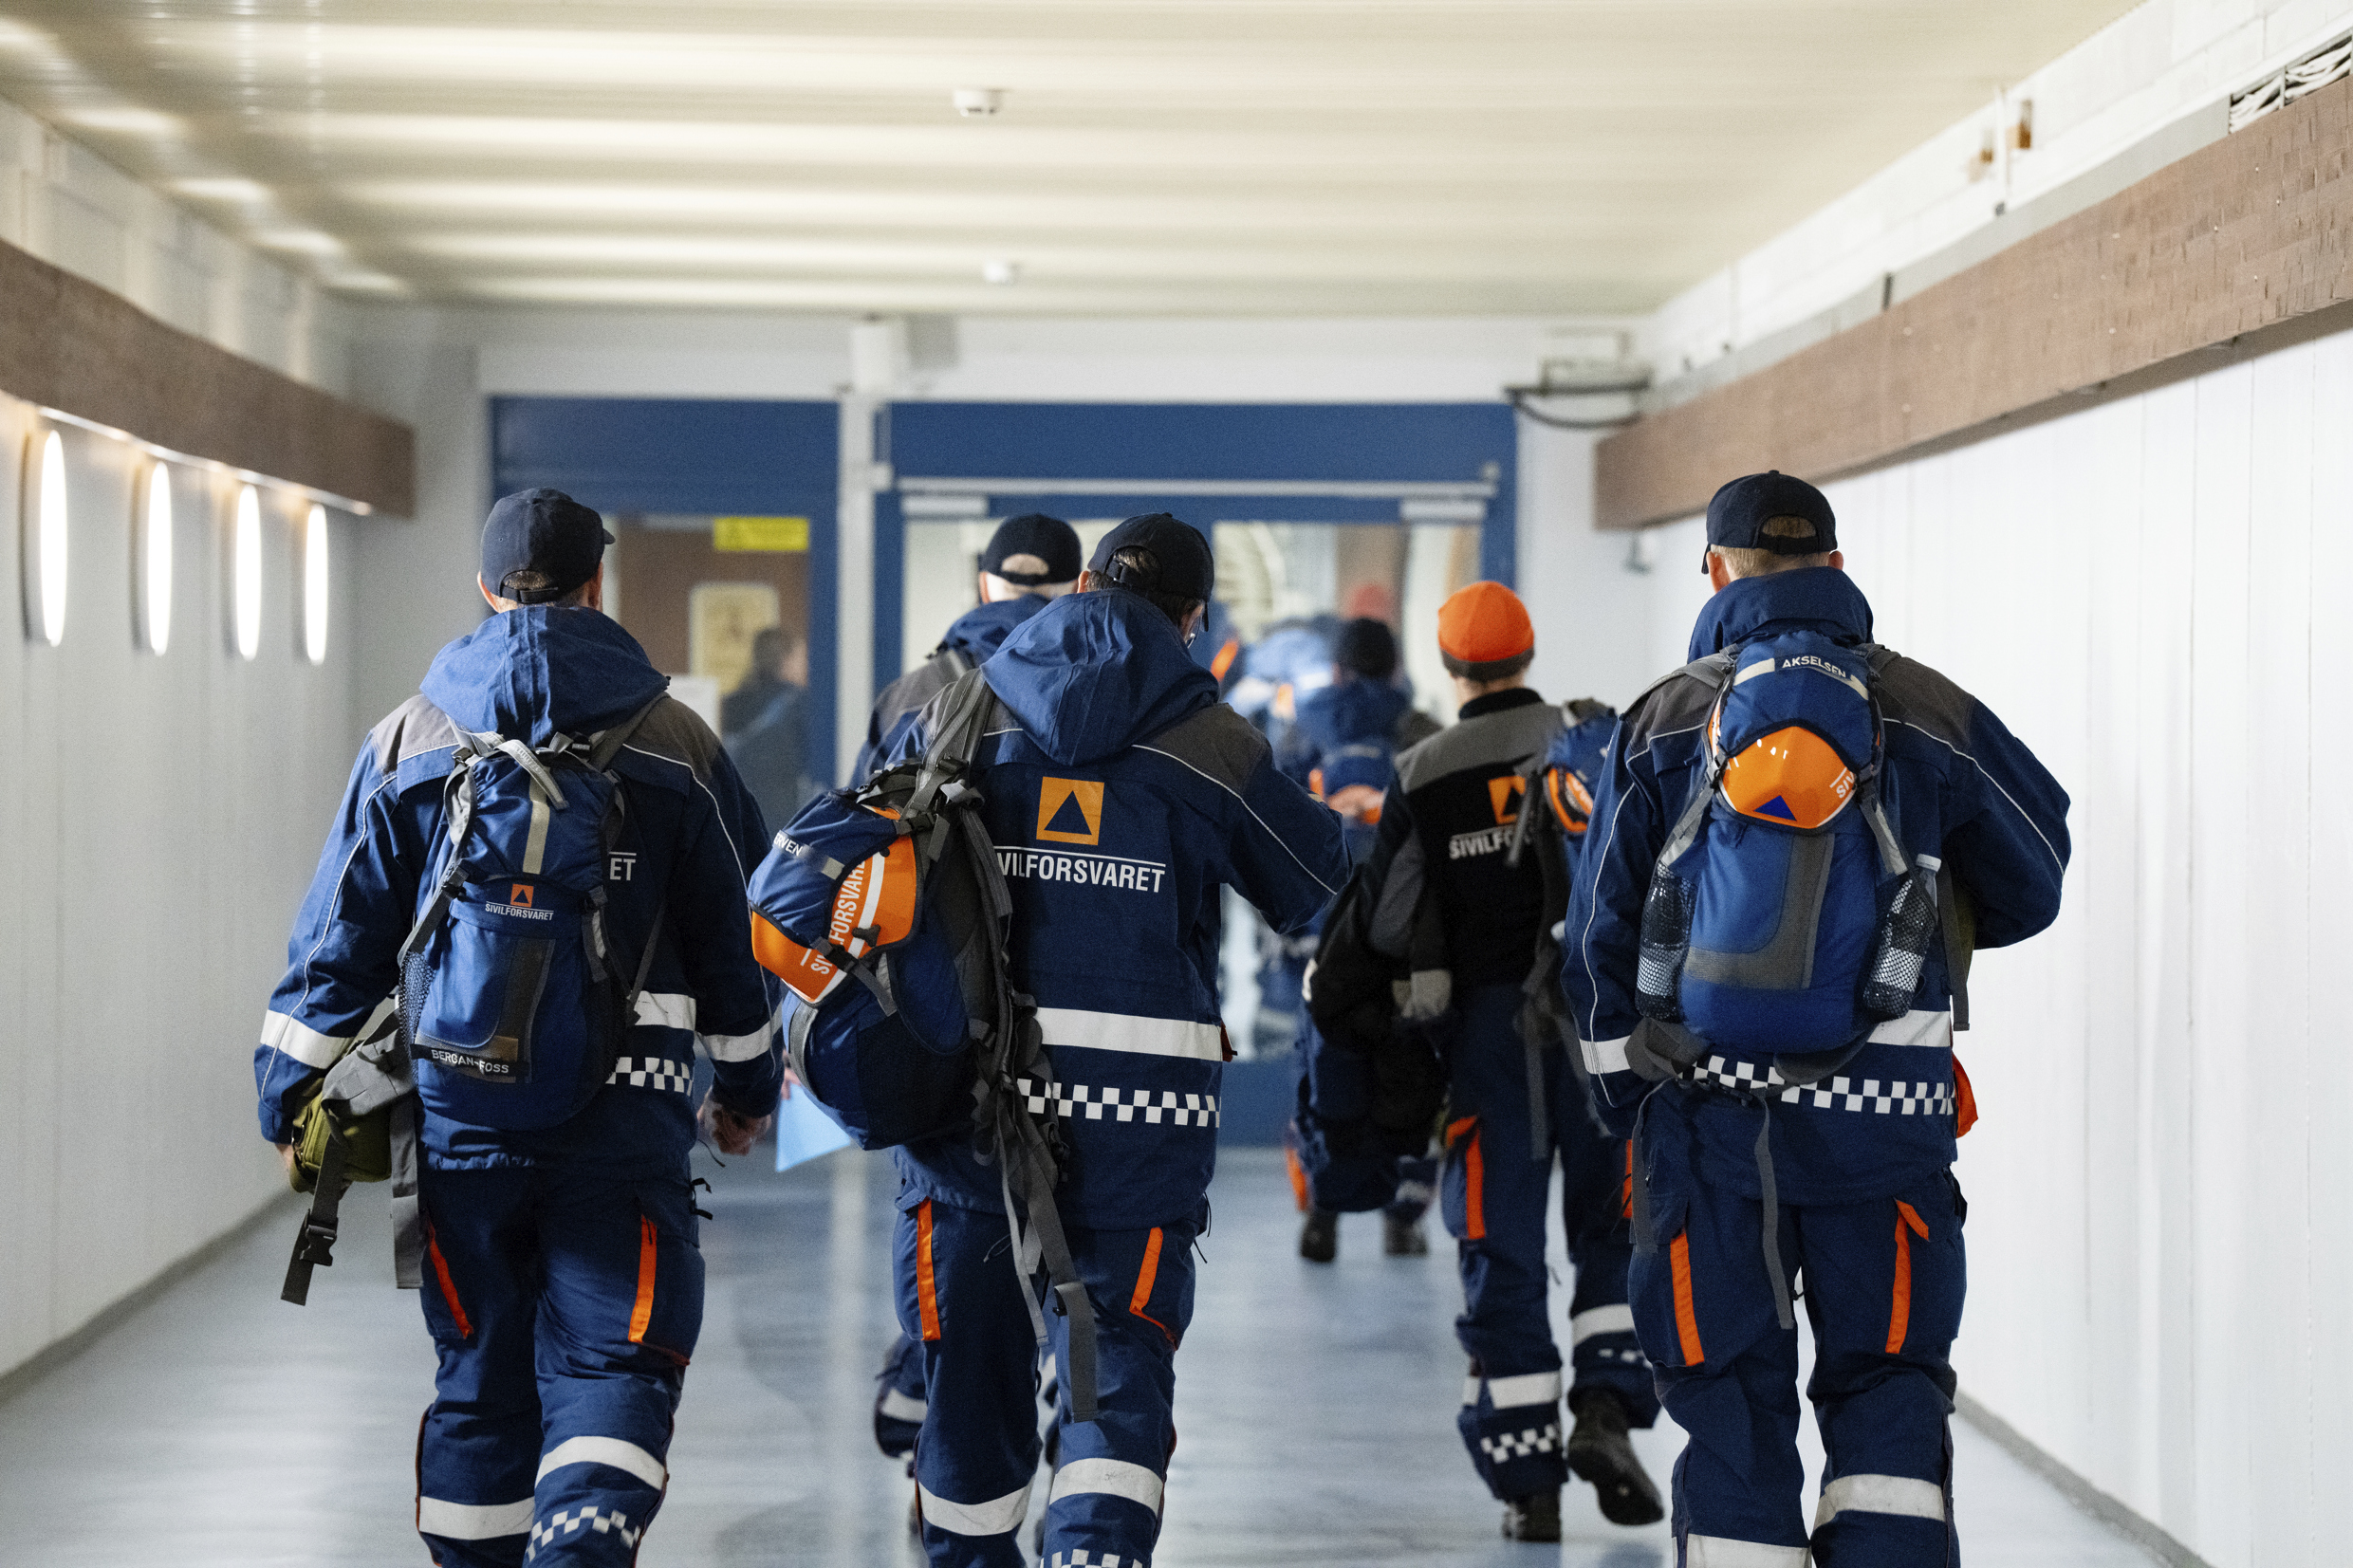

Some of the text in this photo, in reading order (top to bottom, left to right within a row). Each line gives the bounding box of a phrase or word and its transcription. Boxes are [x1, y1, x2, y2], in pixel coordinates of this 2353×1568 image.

[1782, 655, 1846, 678] AKSELSEN
[1836, 770, 1855, 799] SIV
[609, 858, 637, 881] ET
[996, 852, 1166, 894] VILFORSVARET
[485, 903, 554, 921] SIVILFORSVARET
[431, 1049, 510, 1074] BERGAN-FOSS
